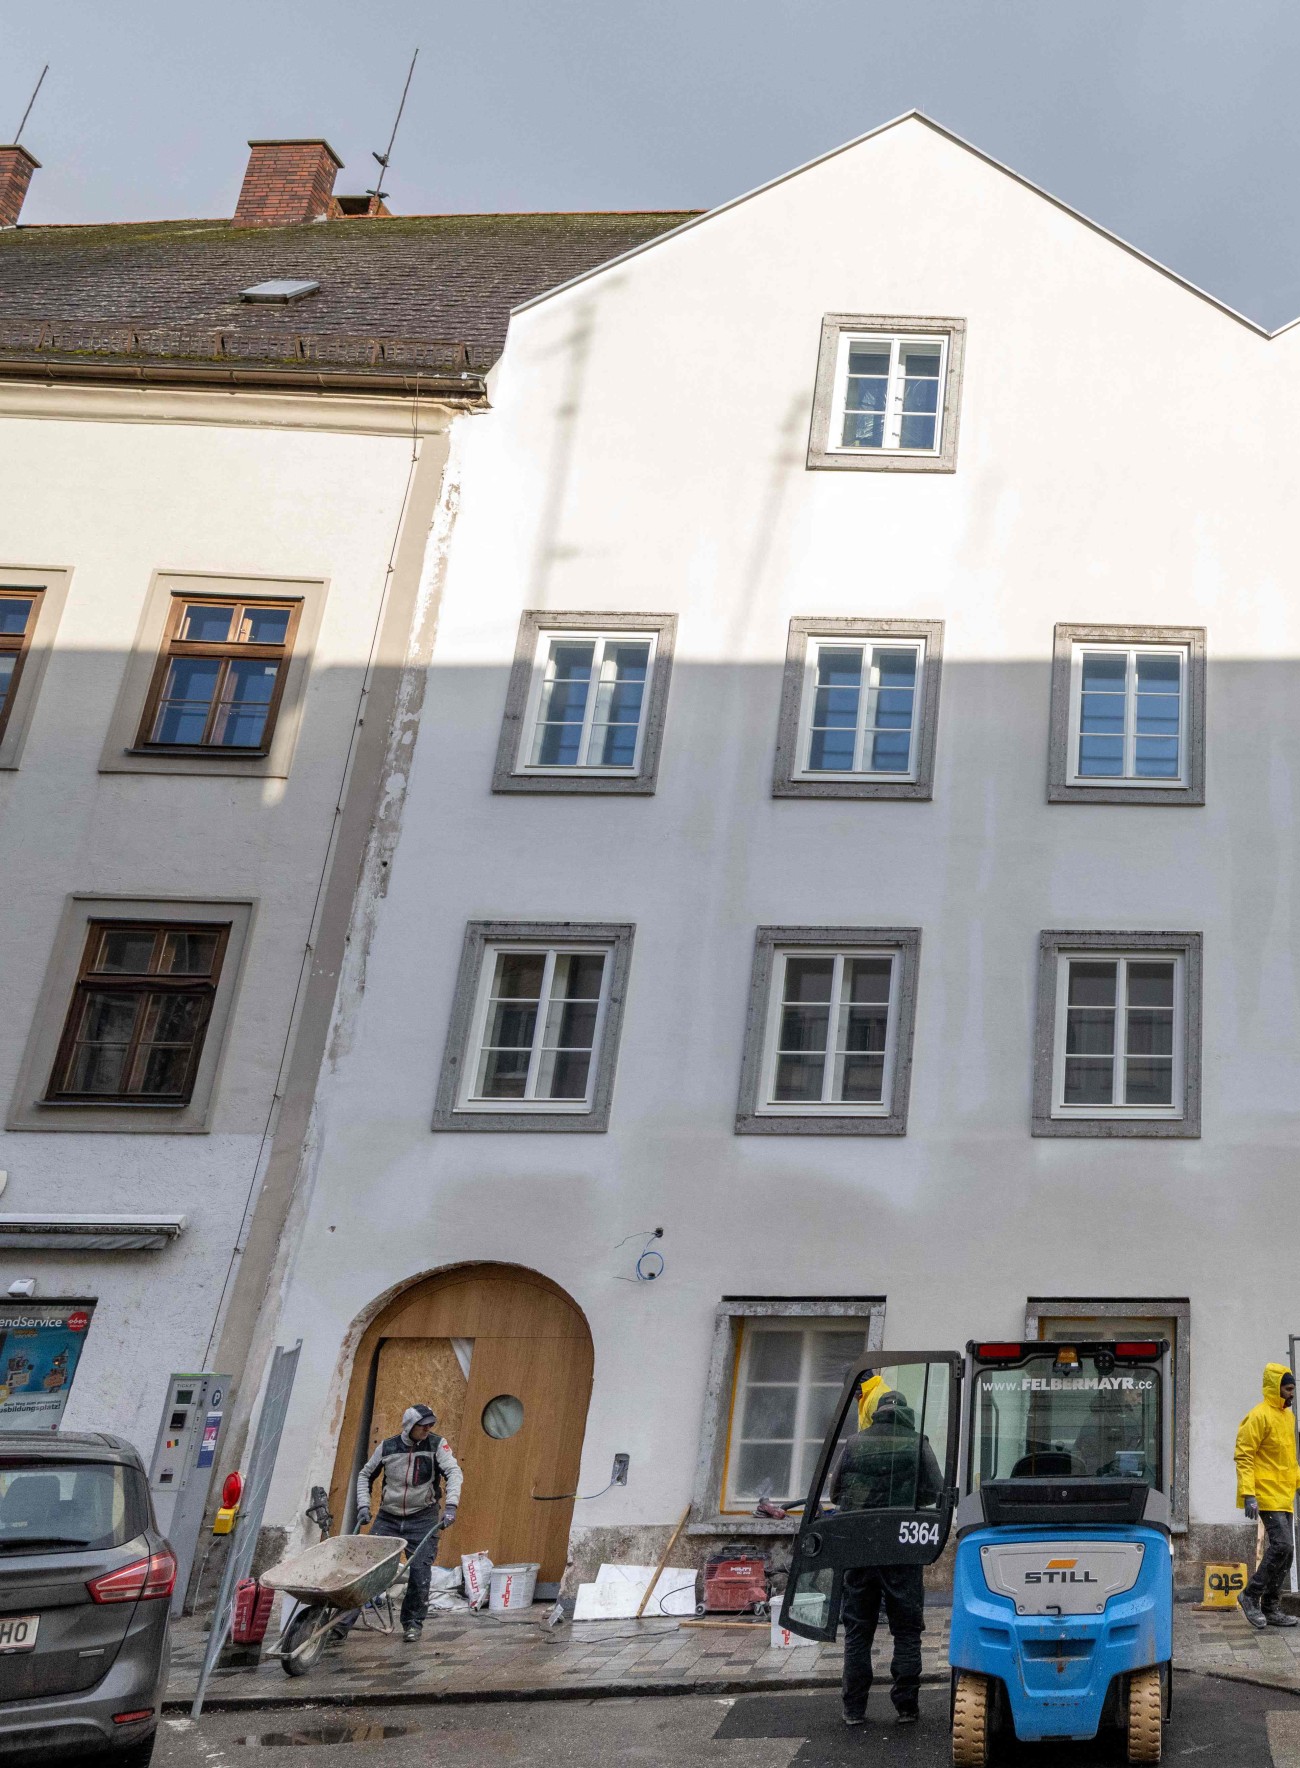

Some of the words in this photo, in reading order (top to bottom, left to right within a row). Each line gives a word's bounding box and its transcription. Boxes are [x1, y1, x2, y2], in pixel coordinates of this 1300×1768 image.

[982, 1377, 1153, 1391] www.FELBERMAYR.cc
[899, 1521, 940, 1546] 5364
[1025, 1570, 1098, 1584] STILL
[0, 1621, 29, 1644] HO
